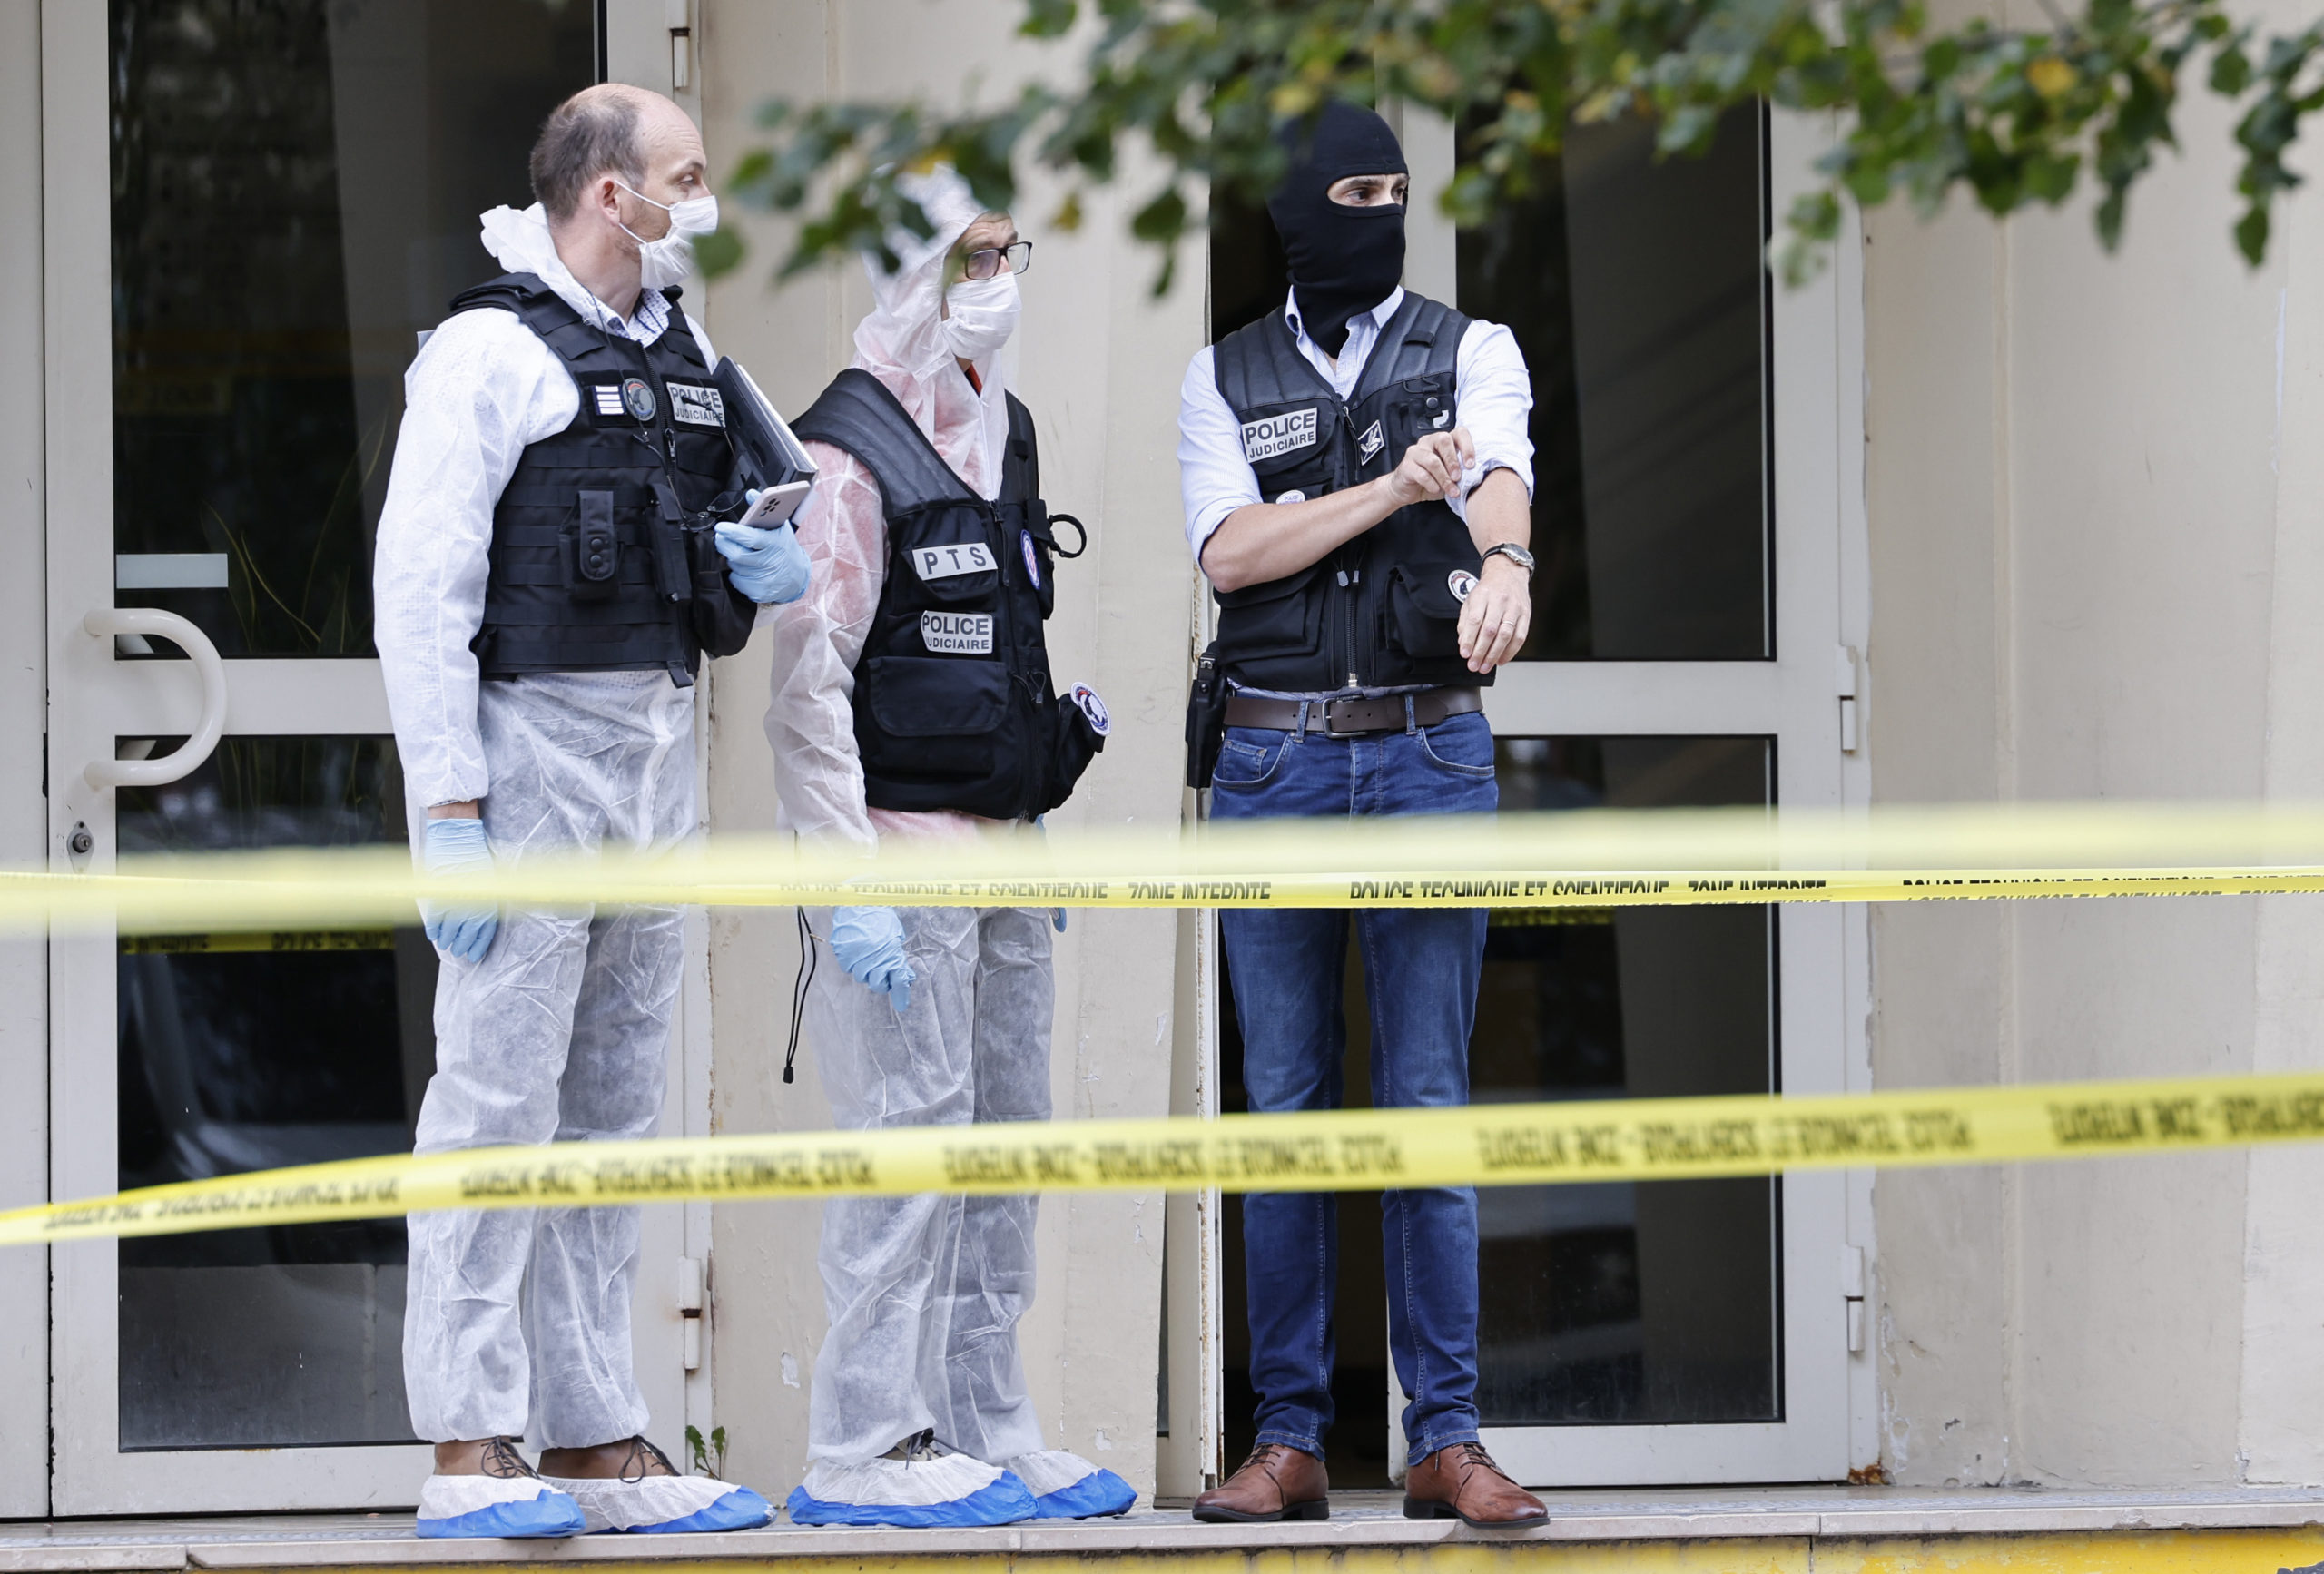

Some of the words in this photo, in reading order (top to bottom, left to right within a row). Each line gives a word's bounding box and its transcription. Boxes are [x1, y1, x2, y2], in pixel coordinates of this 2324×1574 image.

[1245, 412, 1315, 445] POLICE
[1249, 431, 1315, 459] JUDICIAIRE
[922, 615, 990, 635] POLICE
[927, 637, 990, 650] UDICIAIRE
